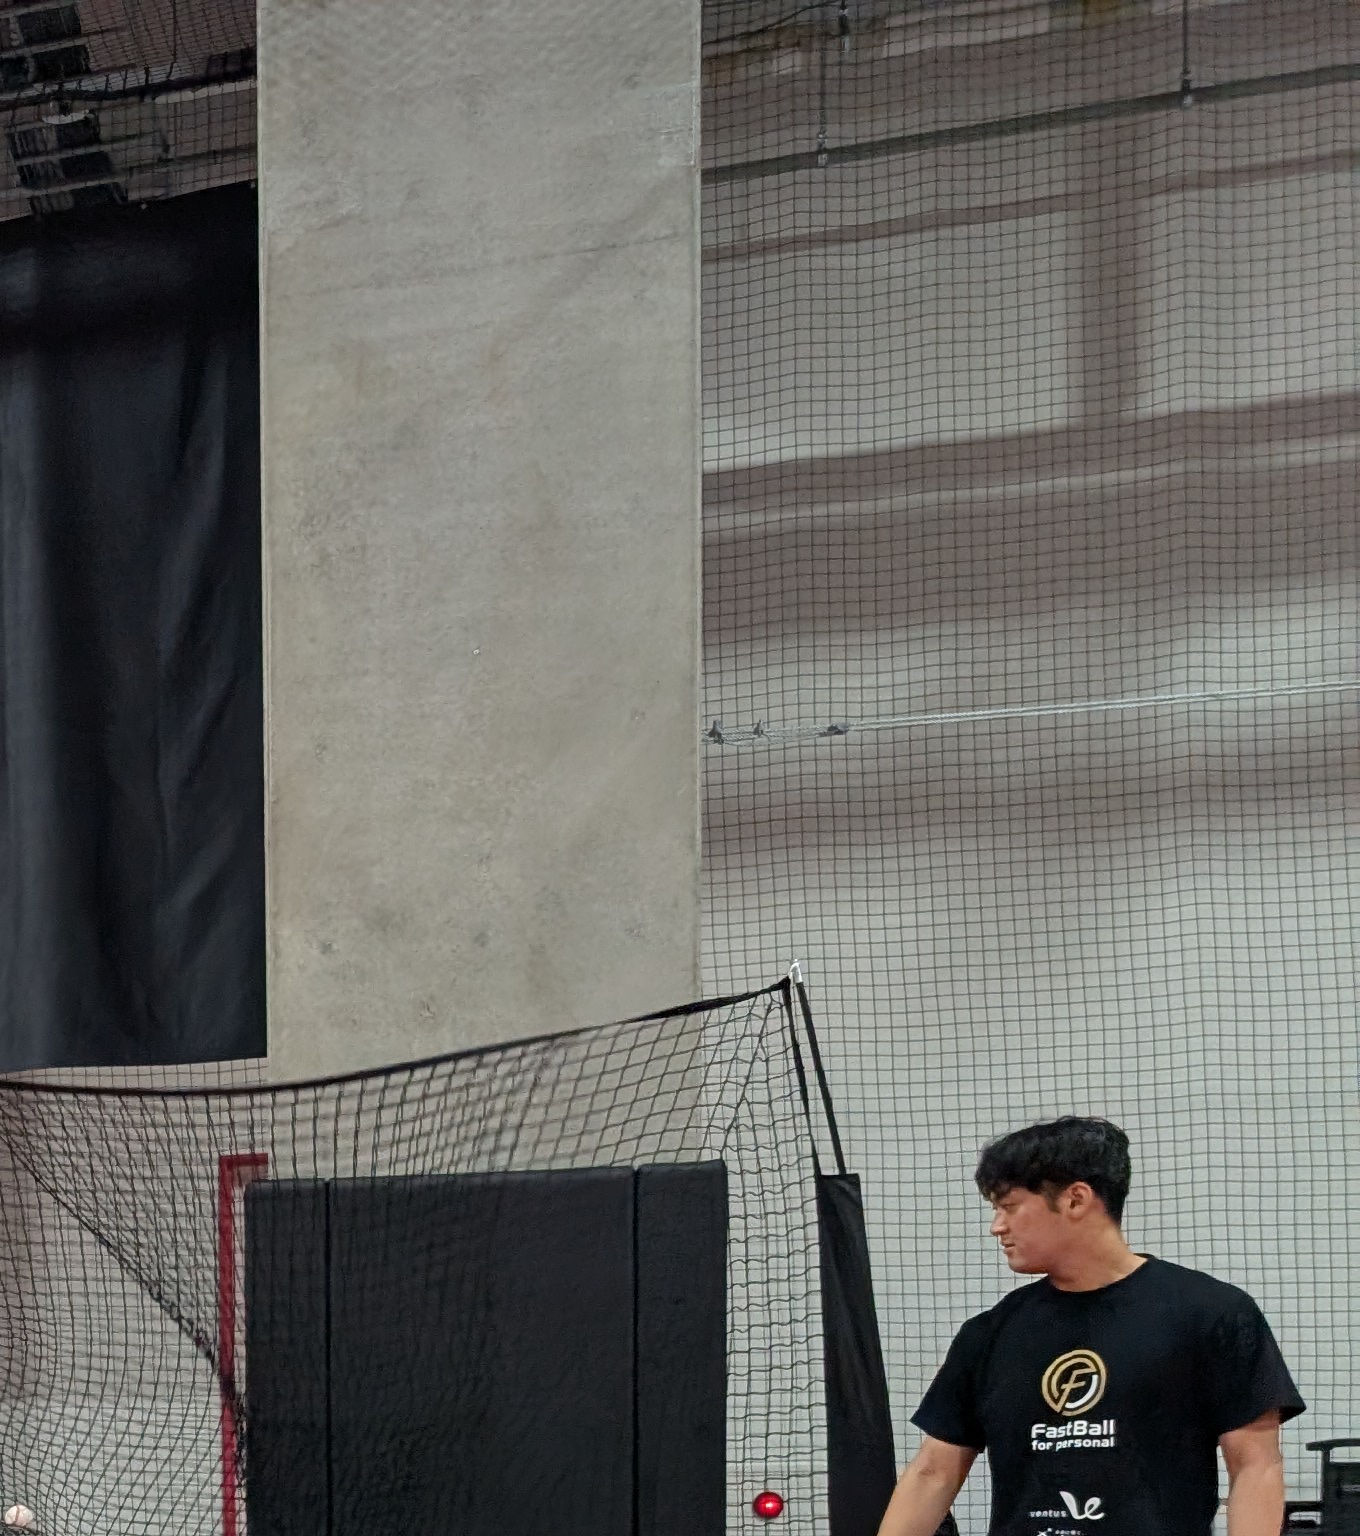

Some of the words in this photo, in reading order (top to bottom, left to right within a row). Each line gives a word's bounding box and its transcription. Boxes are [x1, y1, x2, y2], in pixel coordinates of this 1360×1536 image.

[1031, 1419, 1116, 1439] FastBall
[1031, 1439, 1054, 1451] for
[1055, 1437, 1116, 1452] personal
